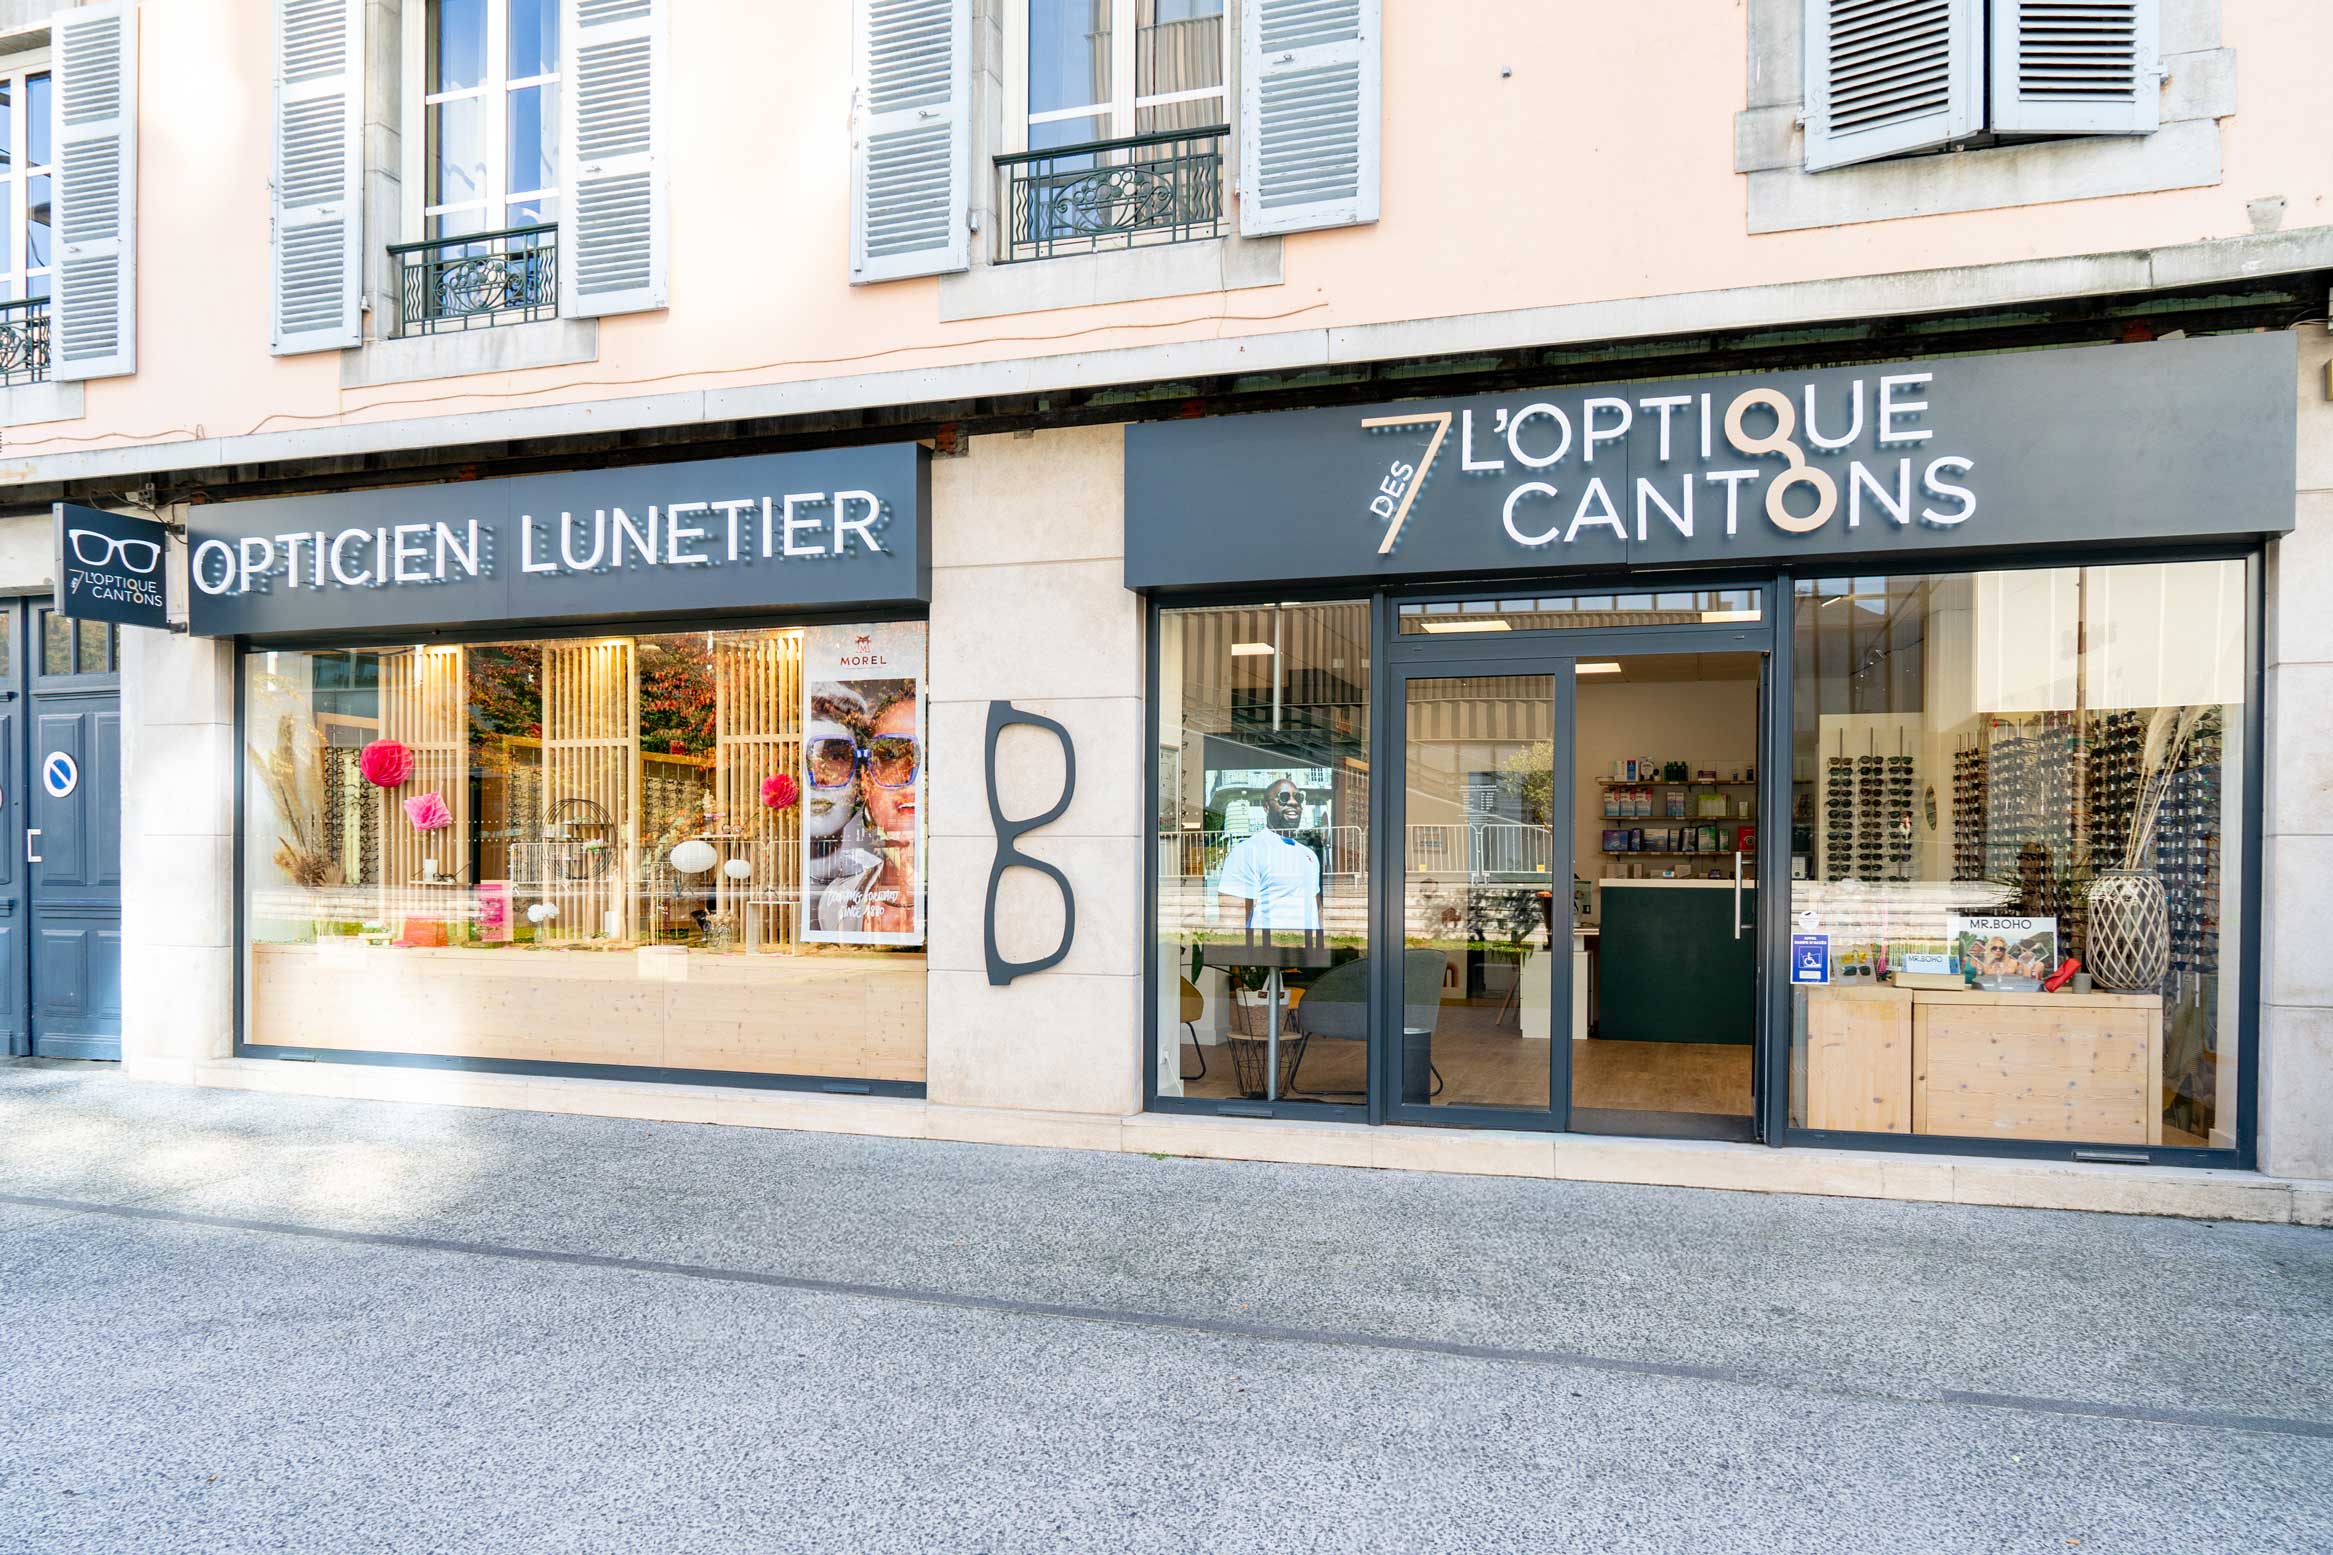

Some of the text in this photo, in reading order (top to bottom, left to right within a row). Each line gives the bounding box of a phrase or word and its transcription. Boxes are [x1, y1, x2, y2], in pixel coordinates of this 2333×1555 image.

[1461, 372, 1934, 472] L'OPTIQUE
[1361, 412, 1977, 554] DES 7 CANTONS
[192, 490, 882, 595] OPTICIEN LUNETIER
[68, 568, 85, 595] 7
[92, 585, 163, 607] CANTONS
[85, 571, 157, 594] L'OPTIQUE
[840, 655, 887, 666] MOREL
[1969, 918, 2032, 930] MR.BOHO
[1908, 954, 1943, 964] MR.BOHO
